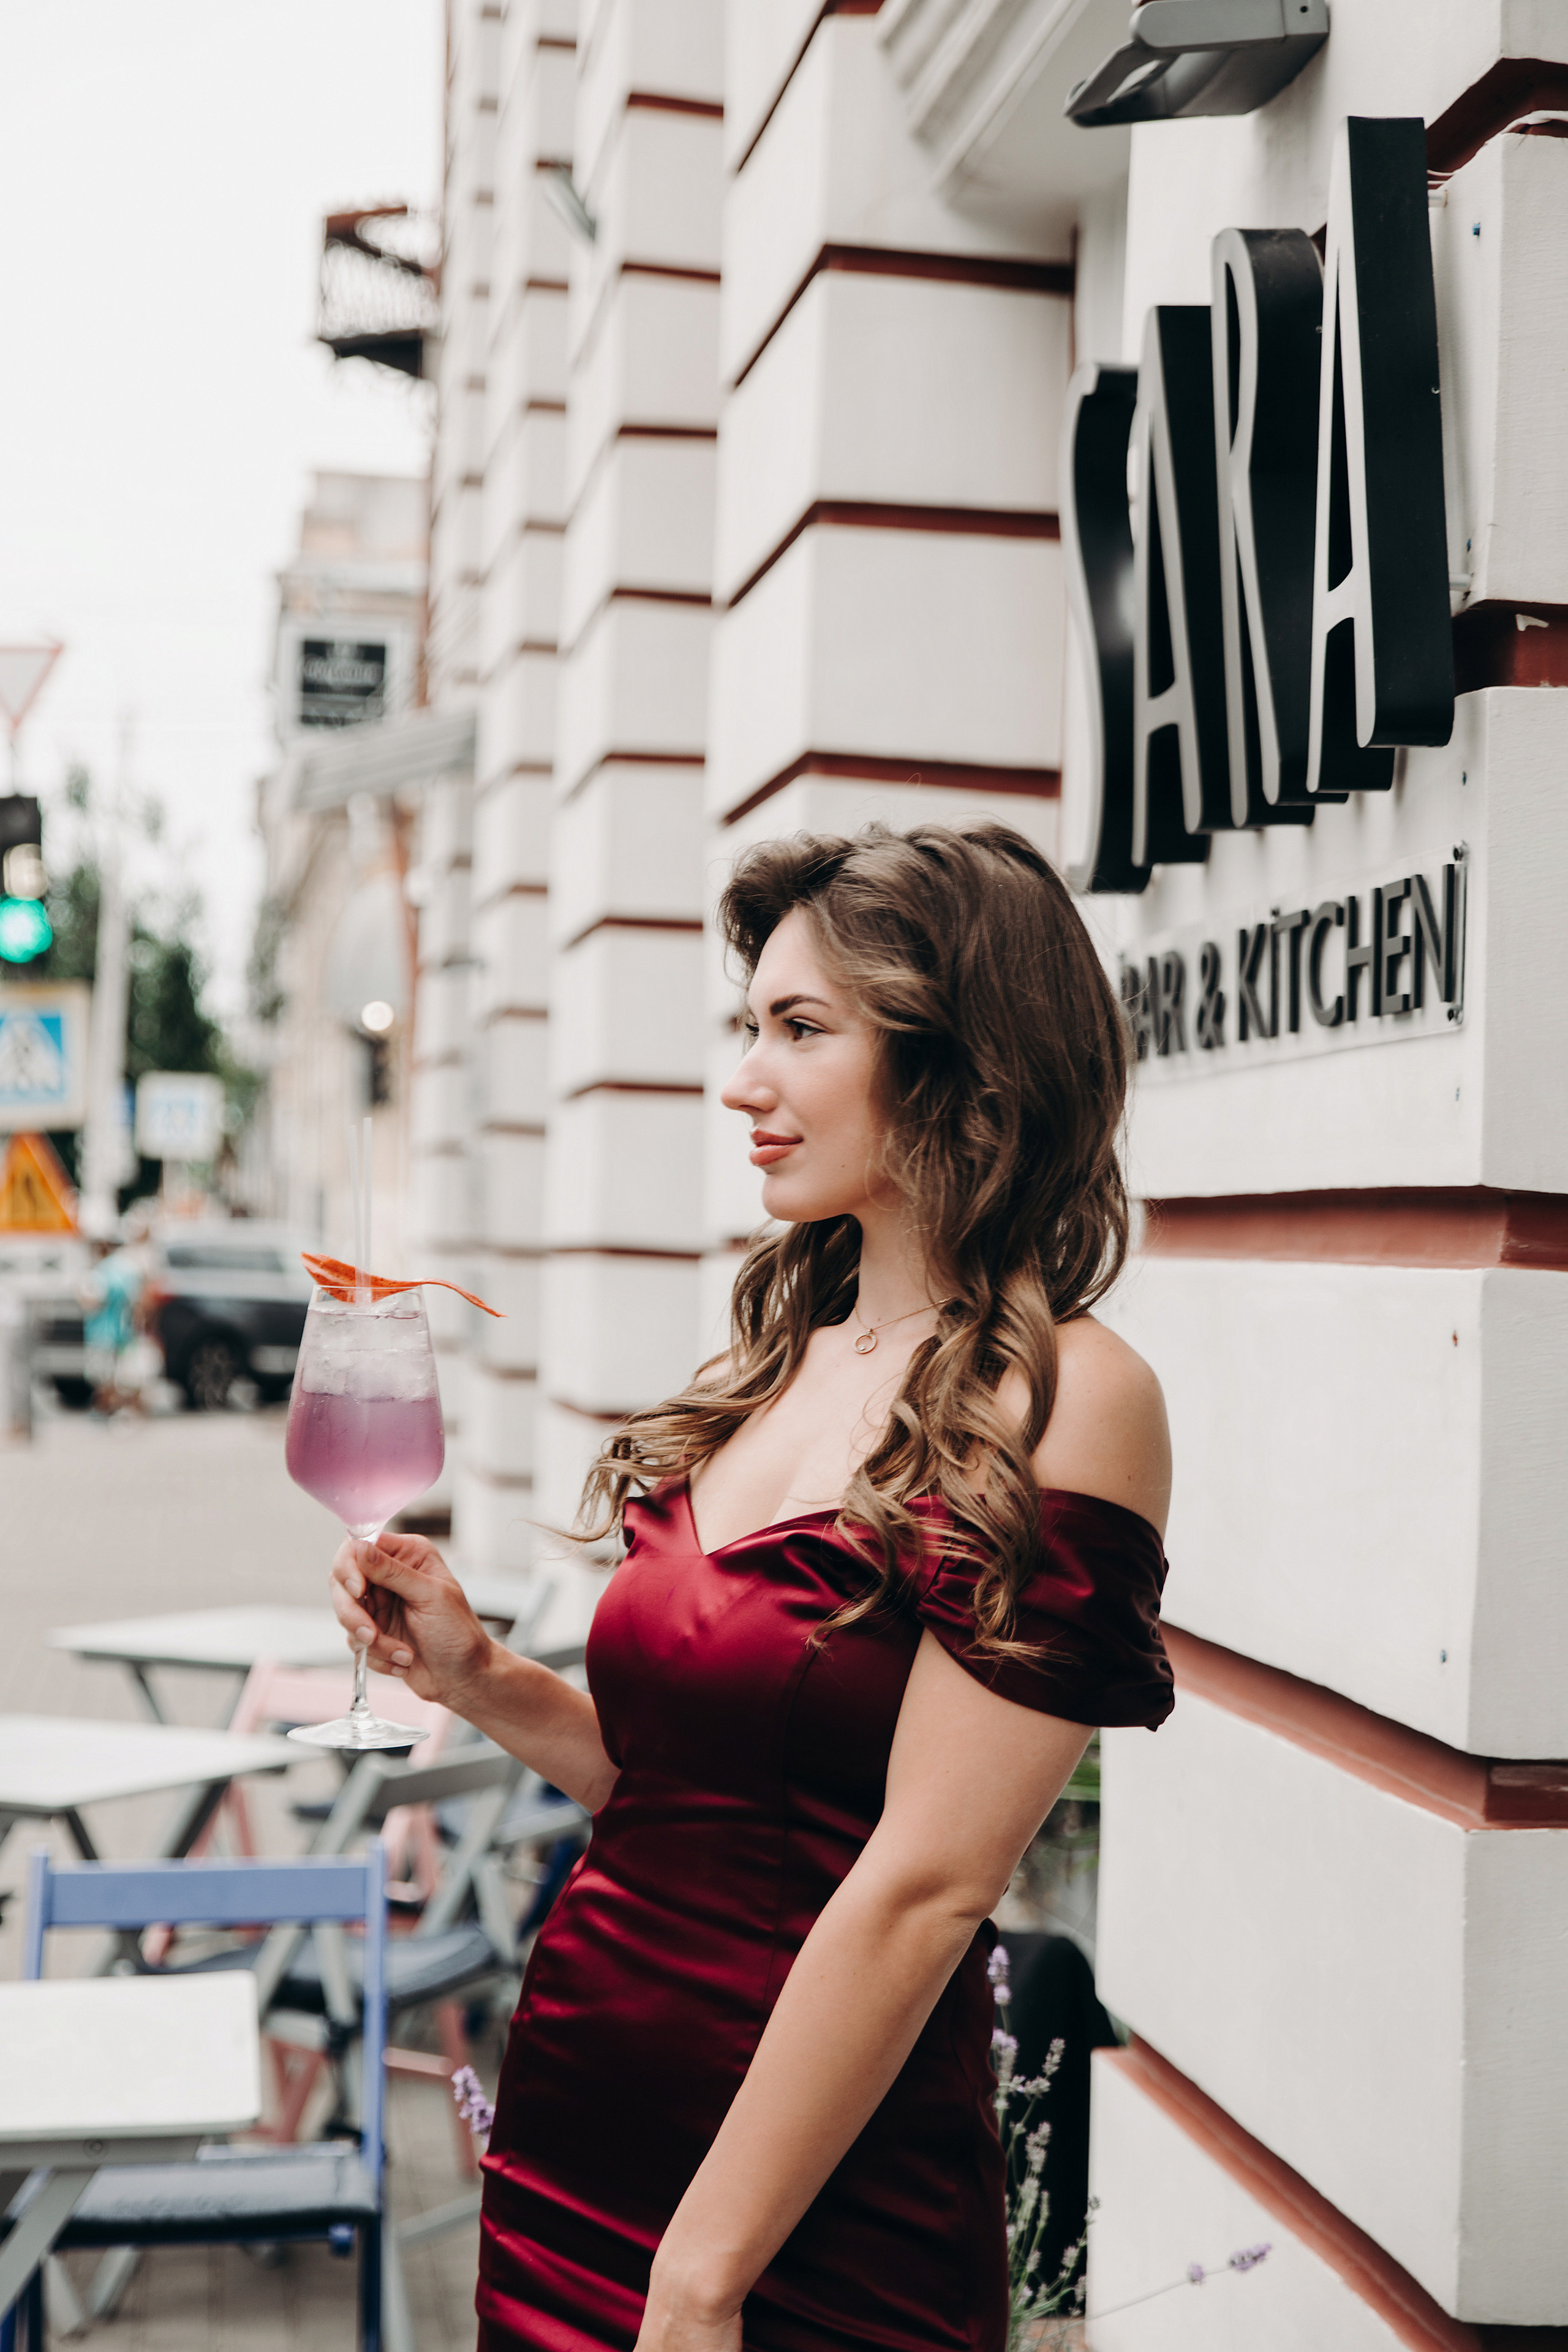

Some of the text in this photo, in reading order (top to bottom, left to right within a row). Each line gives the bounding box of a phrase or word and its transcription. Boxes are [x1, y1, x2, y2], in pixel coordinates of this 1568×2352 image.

[1058, 116, 1453, 895] SARA
[1197, 941, 1225, 1049] &
[1237, 864, 1455, 1041] KITCHEN
